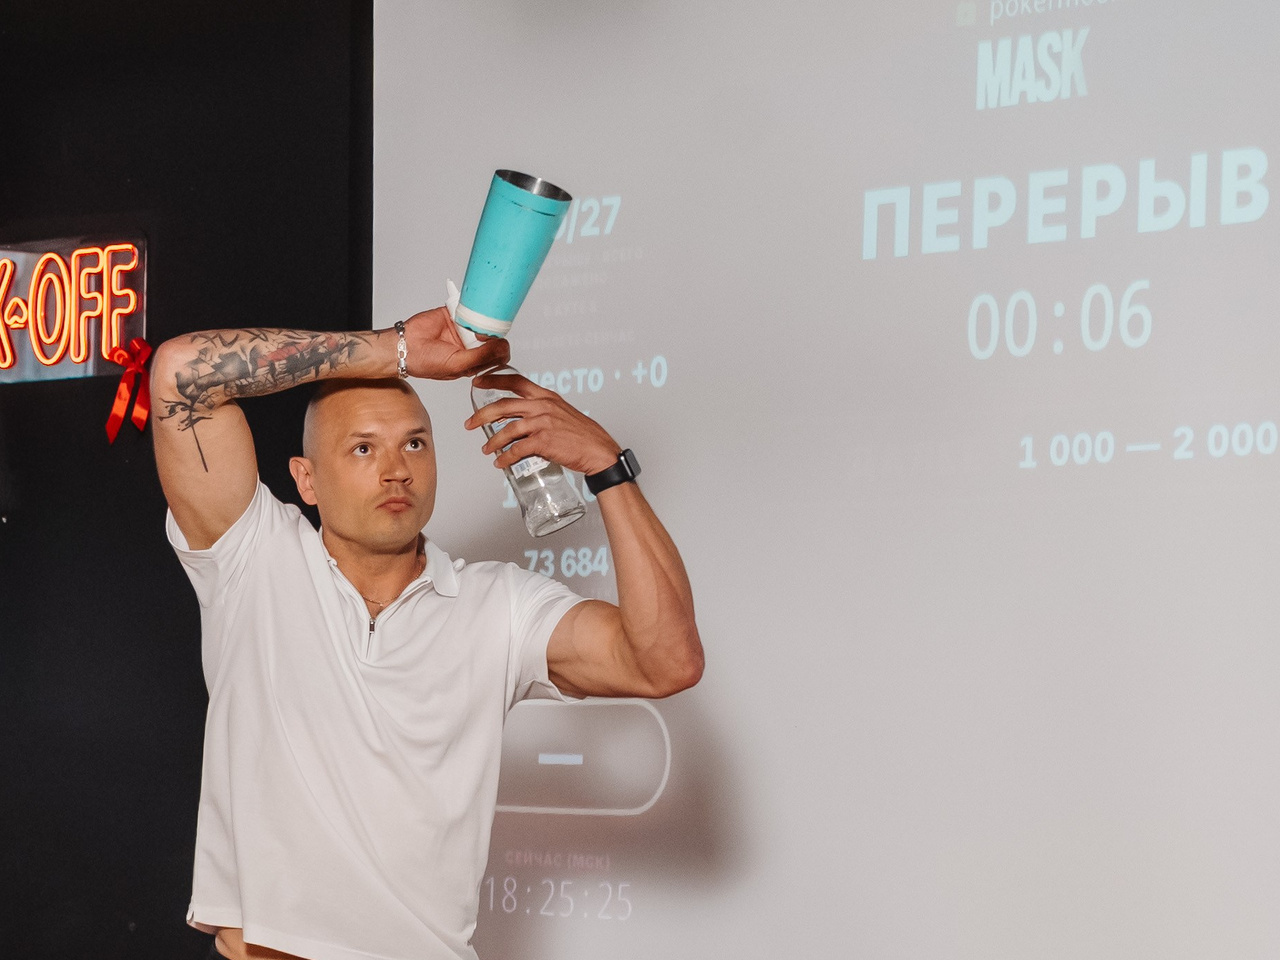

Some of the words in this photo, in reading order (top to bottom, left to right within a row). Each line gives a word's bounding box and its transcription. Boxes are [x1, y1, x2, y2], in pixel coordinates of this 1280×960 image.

[975, 25, 1091, 111] MASK
[862, 146, 1271, 261] ПЕРЕРЫВ
[27, 243, 139, 366] OFF
[967, 279, 1153, 361] 00:06
[632, 355, 668, 388] +0
[485, 876, 633, 921] 18:25:25
